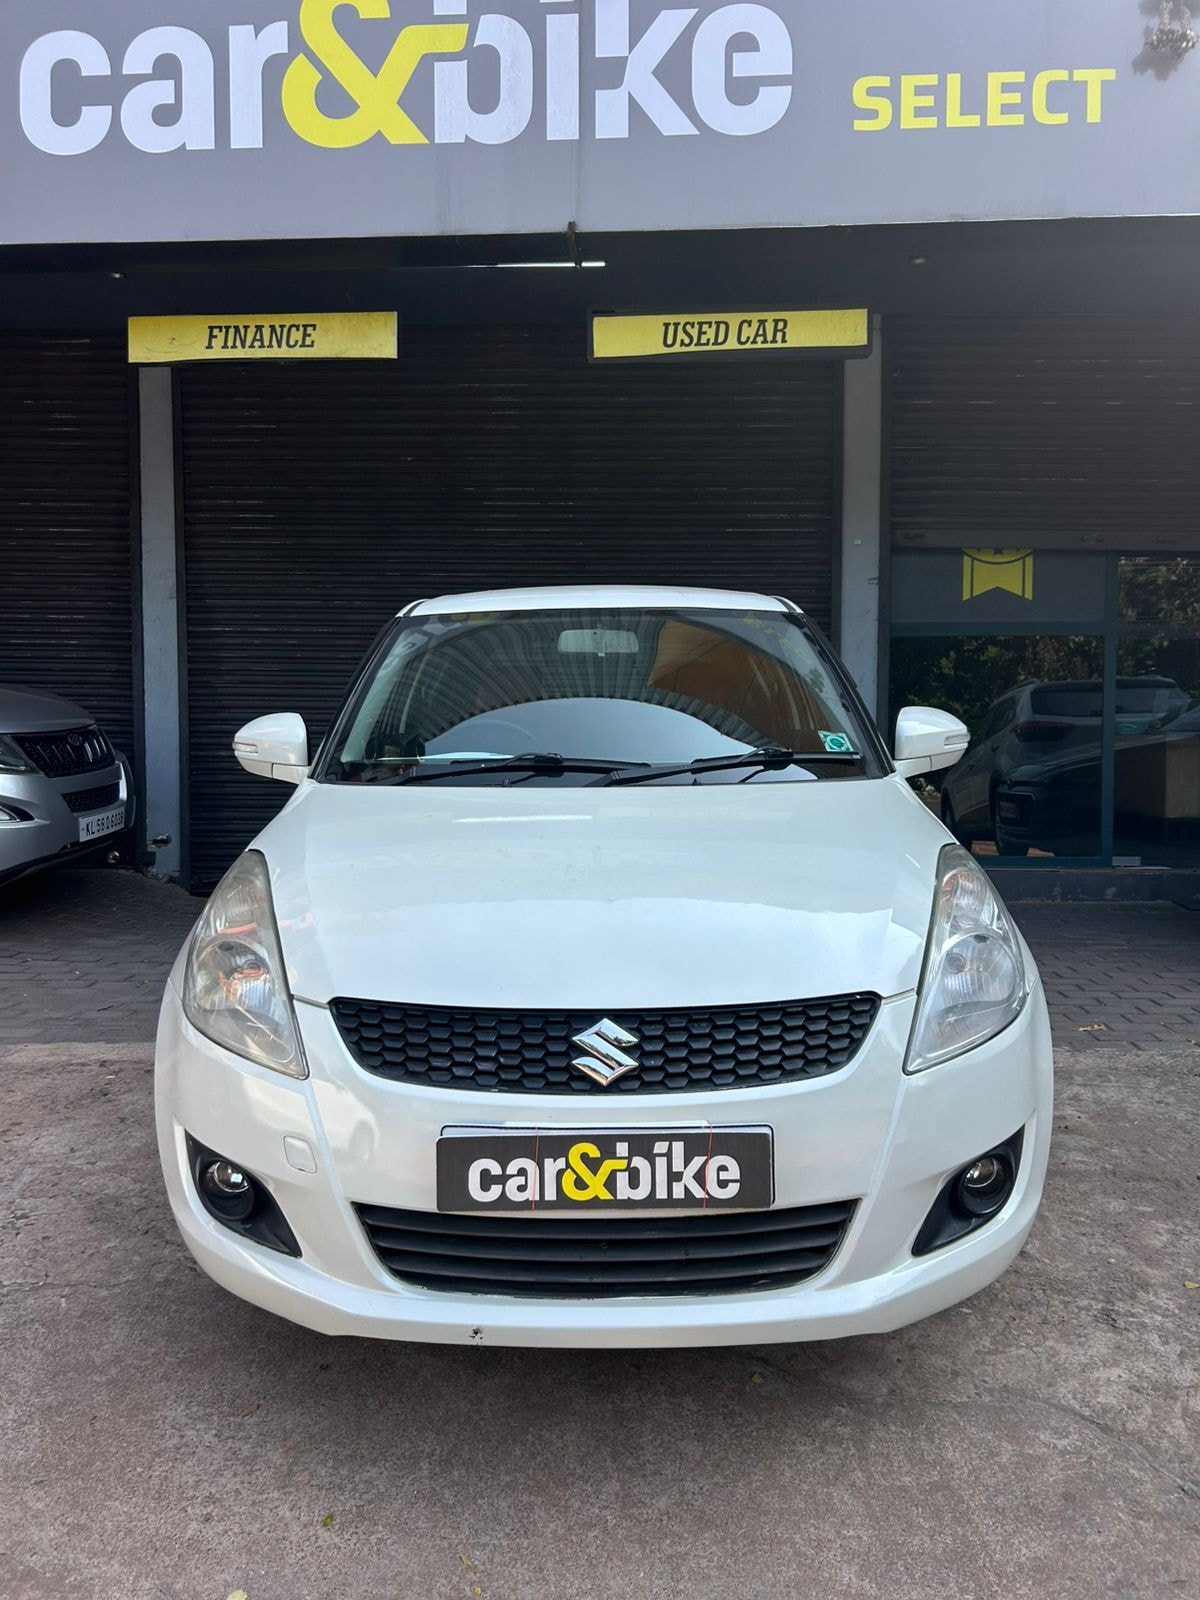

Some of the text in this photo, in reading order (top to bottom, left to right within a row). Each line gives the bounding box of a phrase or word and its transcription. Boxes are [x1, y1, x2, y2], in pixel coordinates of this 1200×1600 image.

[19, 0, 793, 156] car&bike
[851, 68, 1117, 132] SELECT
[205, 323, 317, 351] FINANCE
[662, 318, 789, 349] USED CAR
[86, 820, 95, 836] KL
[467, 1140, 742, 1204] car&bike
